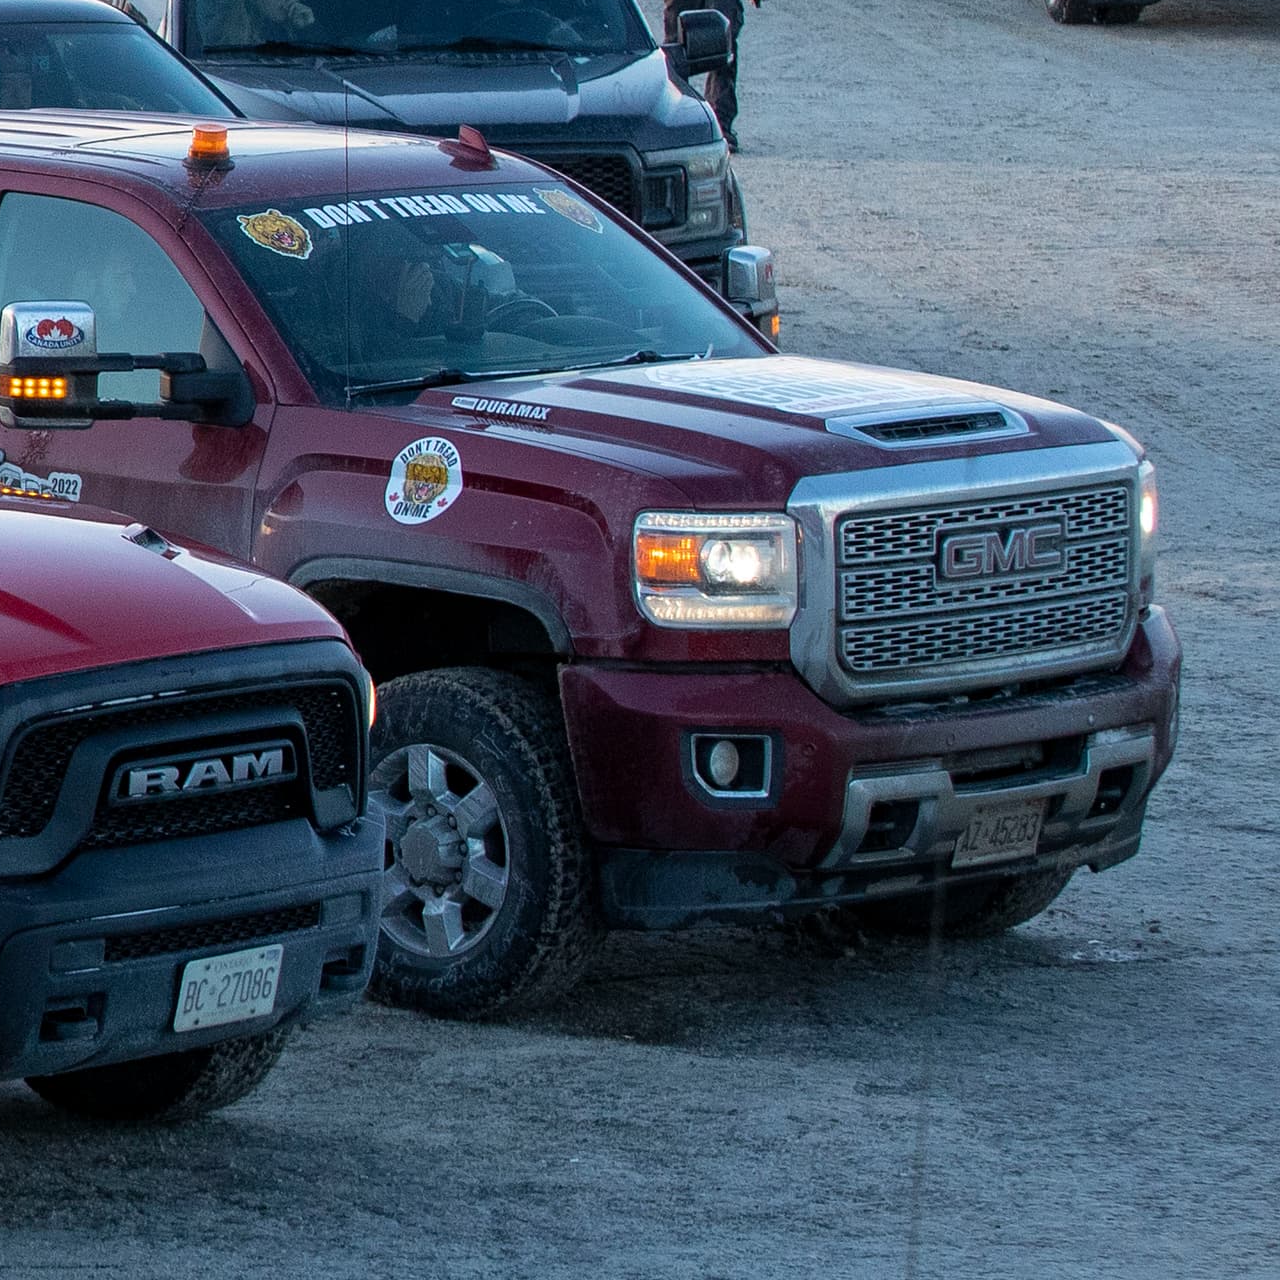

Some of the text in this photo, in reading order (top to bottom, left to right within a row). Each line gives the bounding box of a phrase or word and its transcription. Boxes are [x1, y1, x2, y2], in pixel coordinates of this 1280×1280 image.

[302, 192, 547, 229] DON'T TREAD ON ME
[27, 334, 81, 348] CANADA UNITY
[476, 398, 552, 420] DURAMAX
[399, 439, 458, 469] DON'T TREAD
[51, 477, 79, 496] 2022
[393, 501, 433, 519] ON ME
[943, 524, 1062, 578] GMC
[128, 748, 284, 798] RAM
[183, 966, 276, 1015] BC 27086
